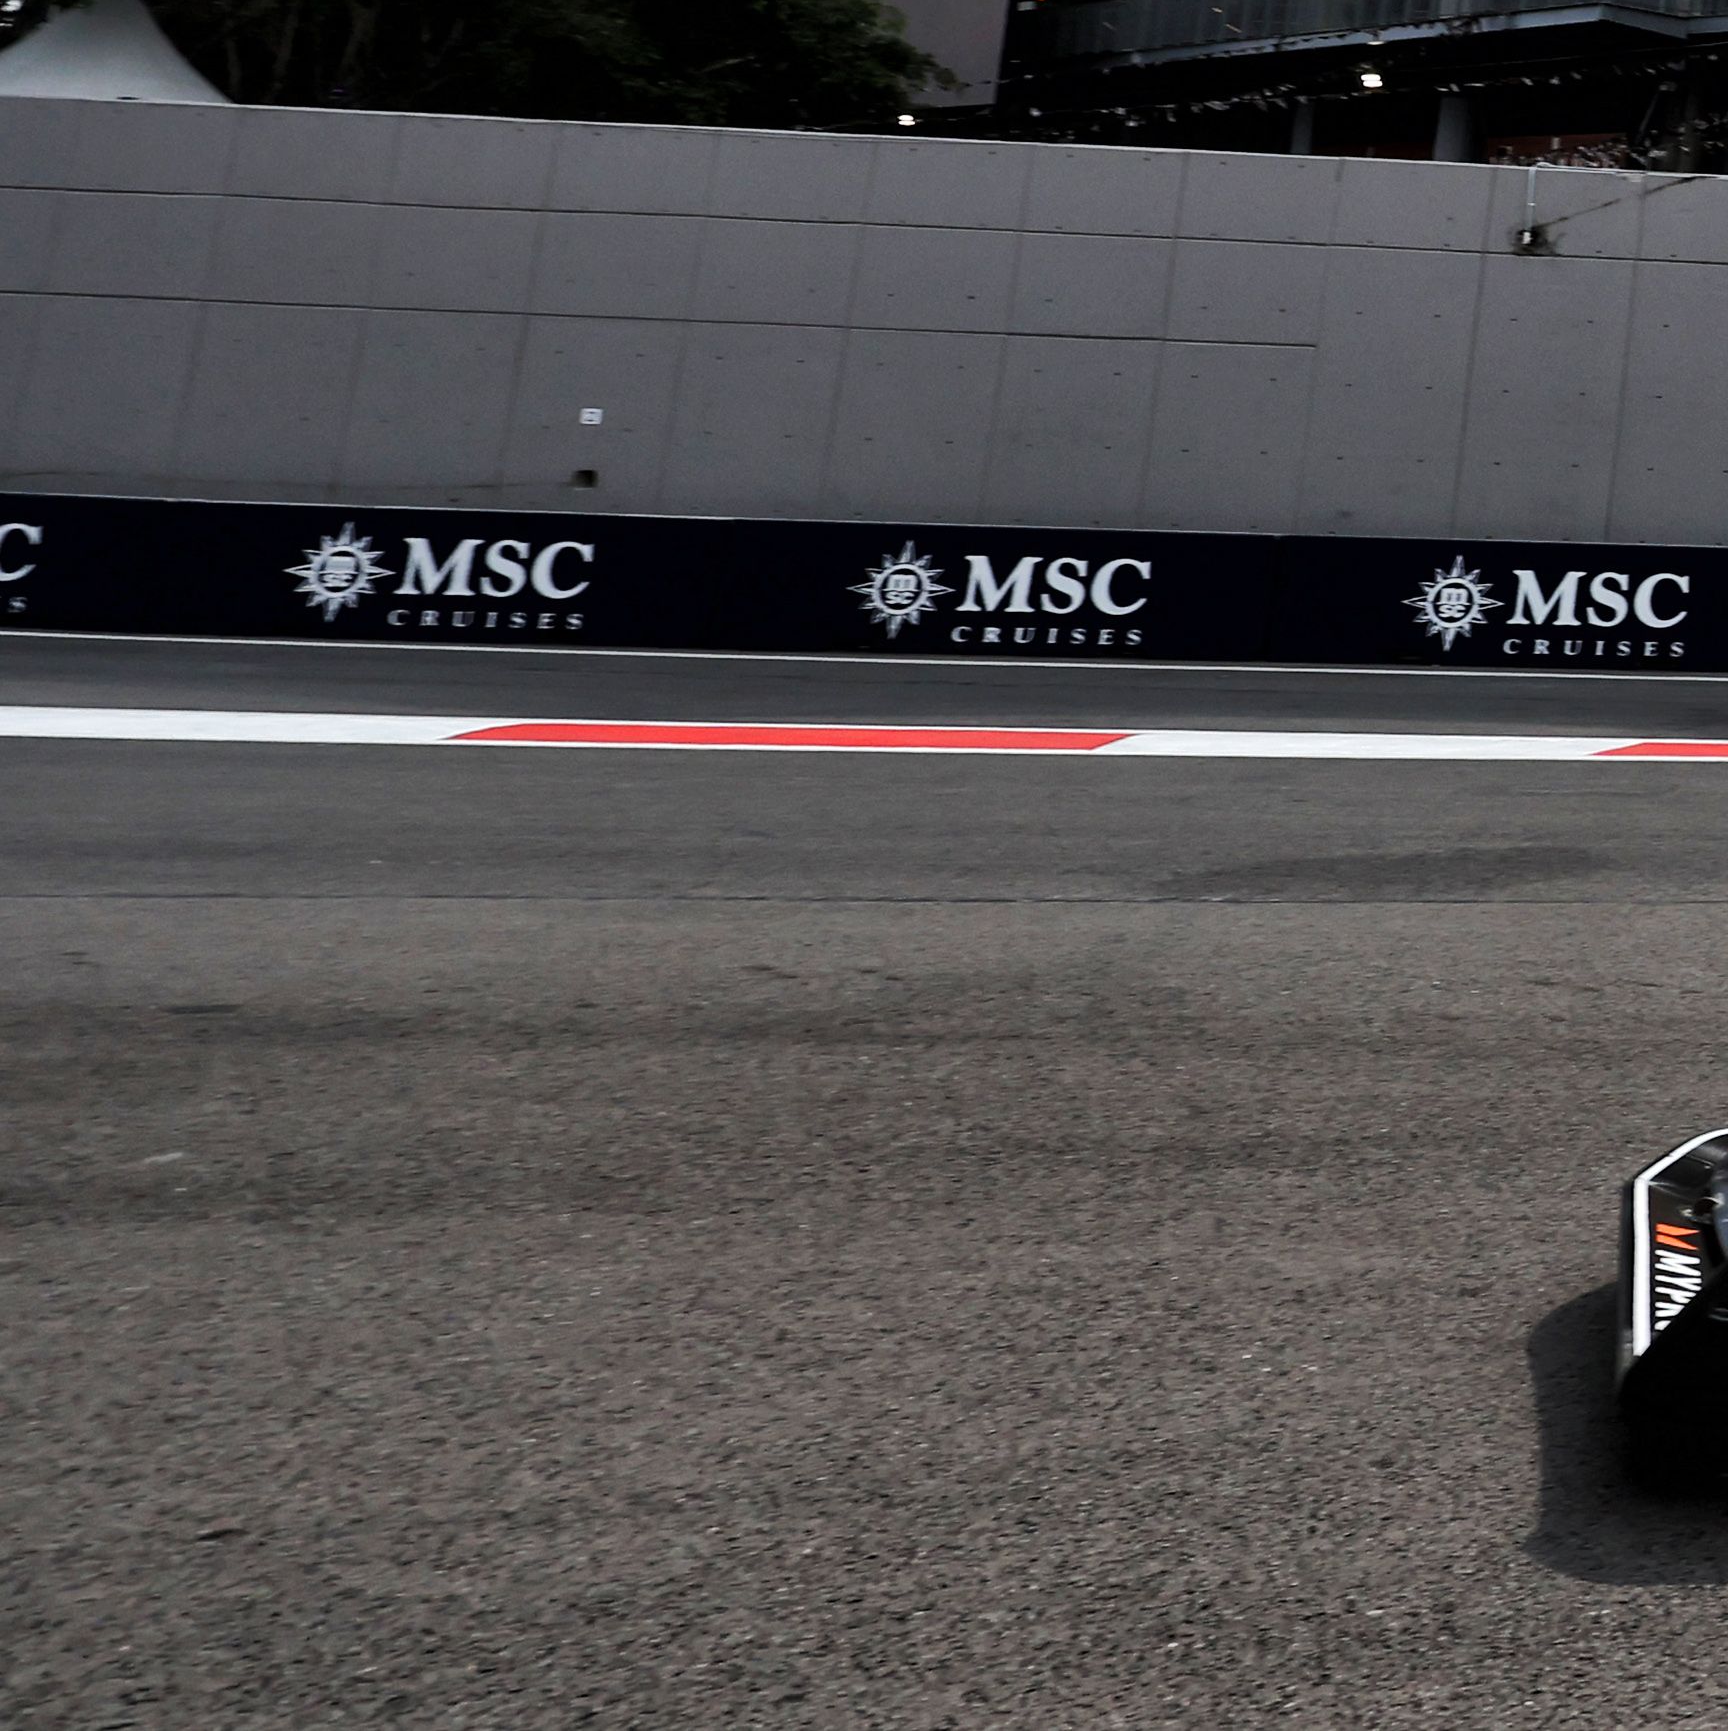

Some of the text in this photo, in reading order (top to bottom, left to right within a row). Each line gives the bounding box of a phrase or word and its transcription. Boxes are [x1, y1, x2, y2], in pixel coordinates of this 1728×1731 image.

[396, 537, 594, 600] MSC
[955, 555, 1152, 616] MSC
[1506, 569, 1690, 629] MSC
[387, 609, 583, 630] CRUISES
[951, 625, 1142, 646] CRUISES
[1503, 638, 1684, 658] CRUISES
